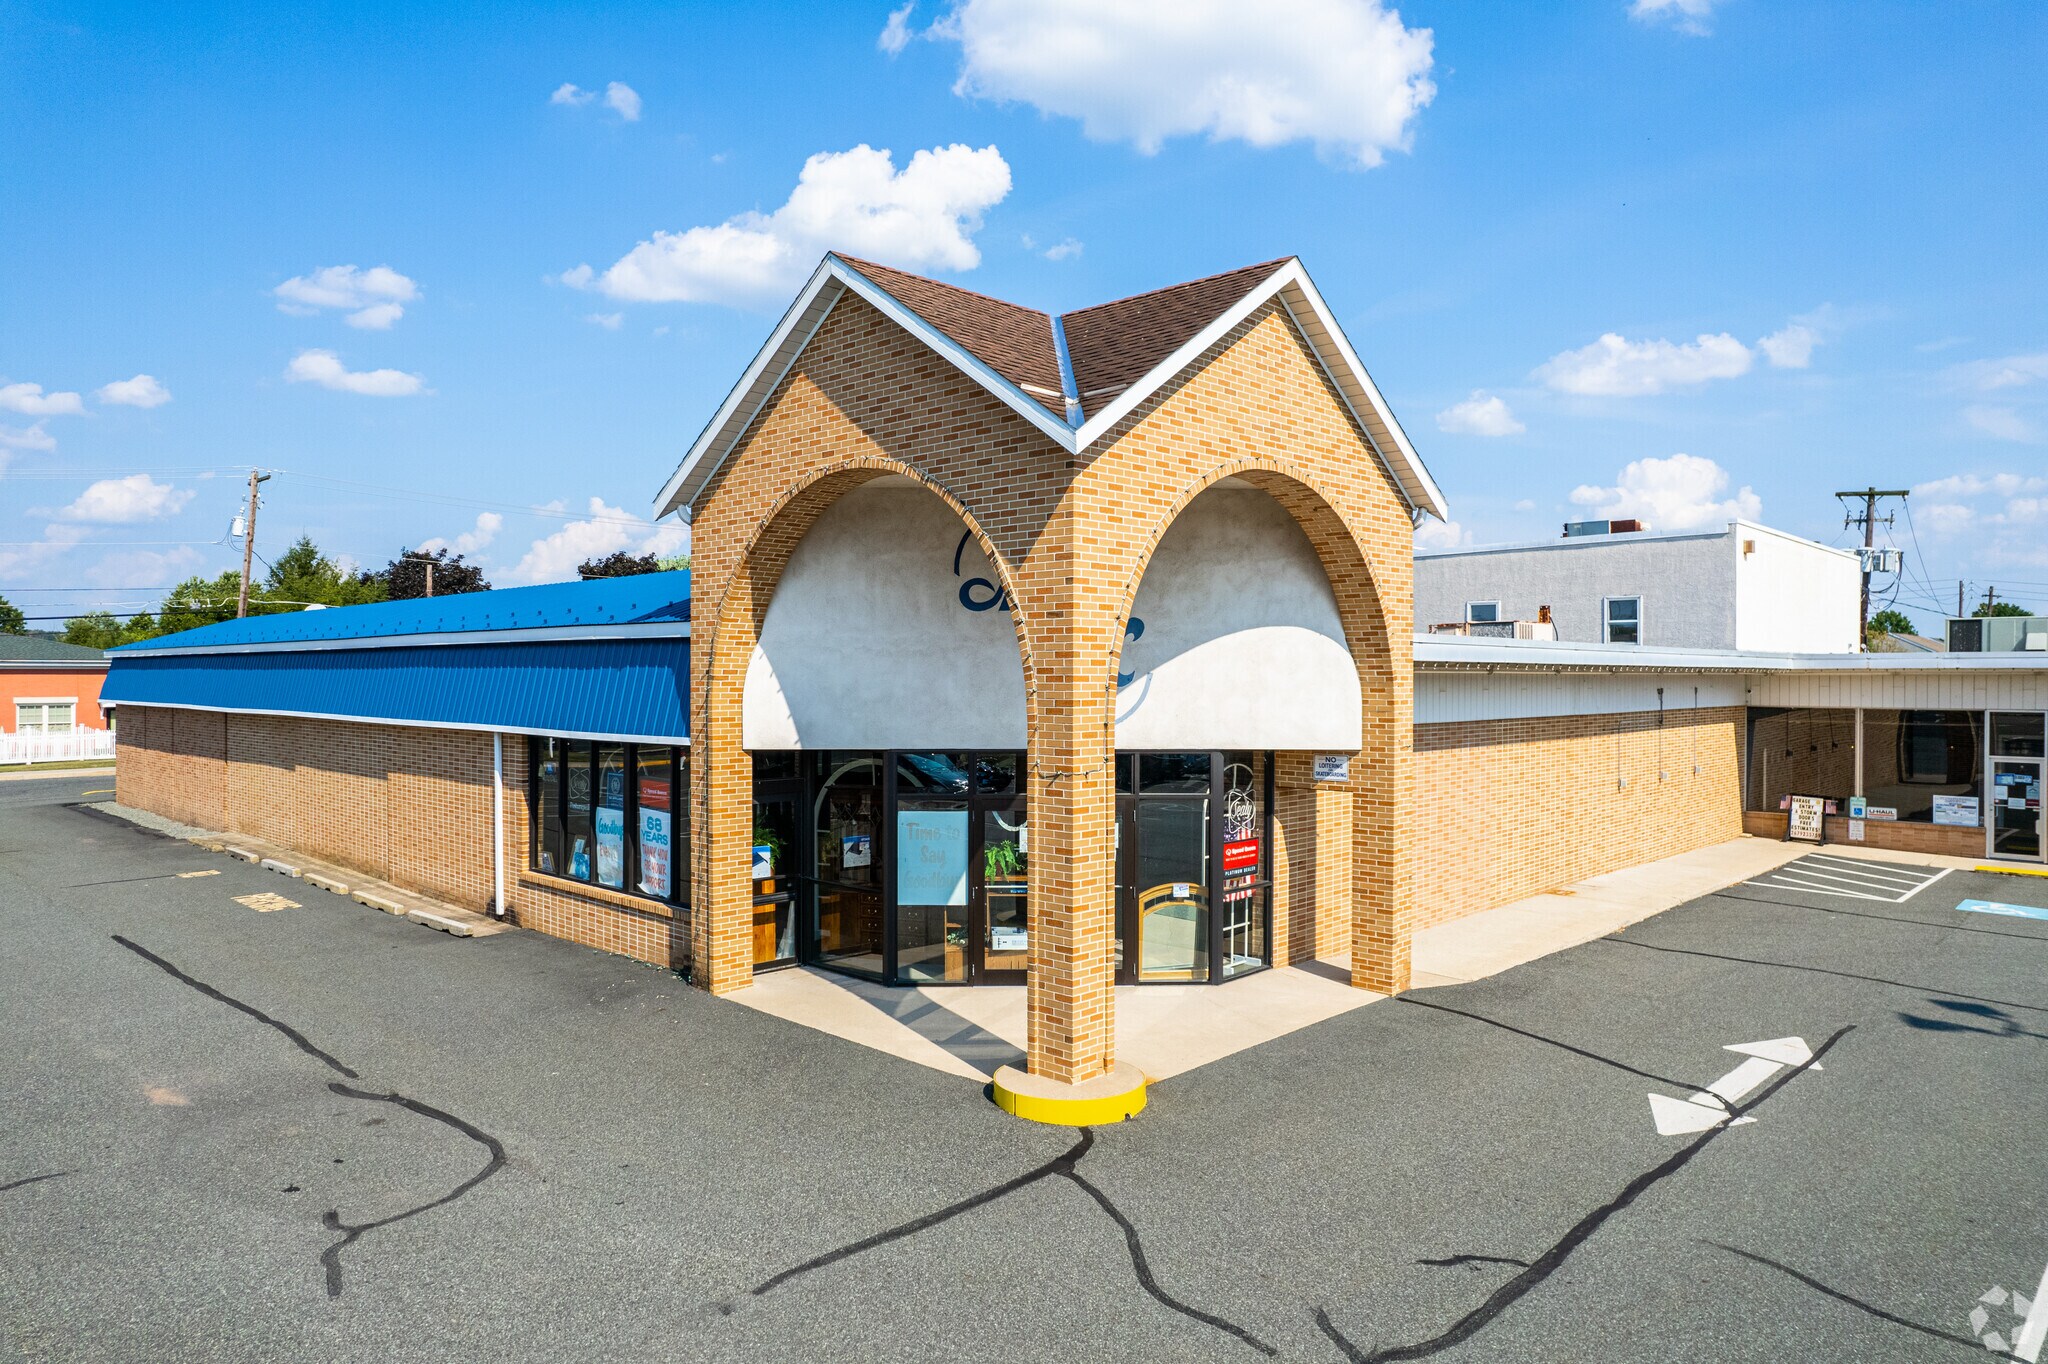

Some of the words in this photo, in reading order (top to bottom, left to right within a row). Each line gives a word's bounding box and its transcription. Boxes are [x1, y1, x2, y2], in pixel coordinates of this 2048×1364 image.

[1232, 800, 1253, 821] Sealy
[647, 816, 662, 833] 68
[906, 822, 941, 840] Time
[641, 829, 669, 846] YEARS
[920, 845, 947, 869] Say
[1231, 846, 1244, 855] Speed
[1225, 868, 1243, 877] PLATINUM
[1243, 865, 1256, 873] DEALER
